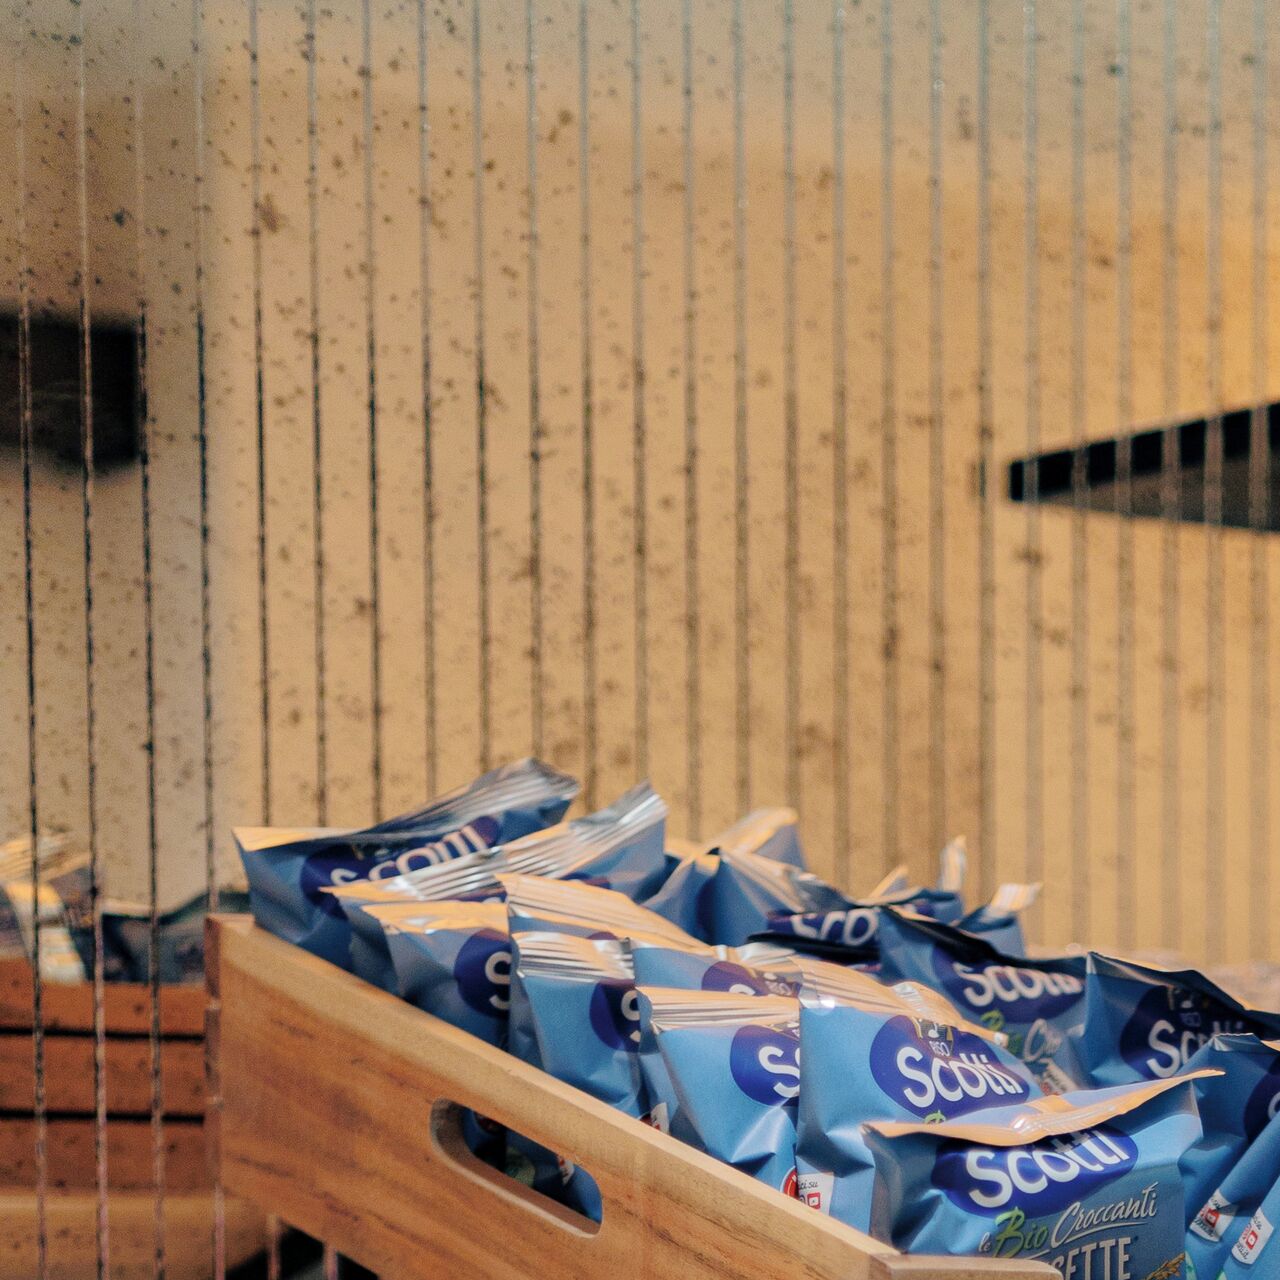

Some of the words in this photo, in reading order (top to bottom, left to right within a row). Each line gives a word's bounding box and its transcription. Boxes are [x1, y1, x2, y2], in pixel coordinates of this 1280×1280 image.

[896, 1046, 1024, 1108] Scotti
[966, 1130, 1131, 1209] Scotti
[994, 1206, 1049, 1259] Bio
[1050, 1181, 1159, 1250] Croccanti
